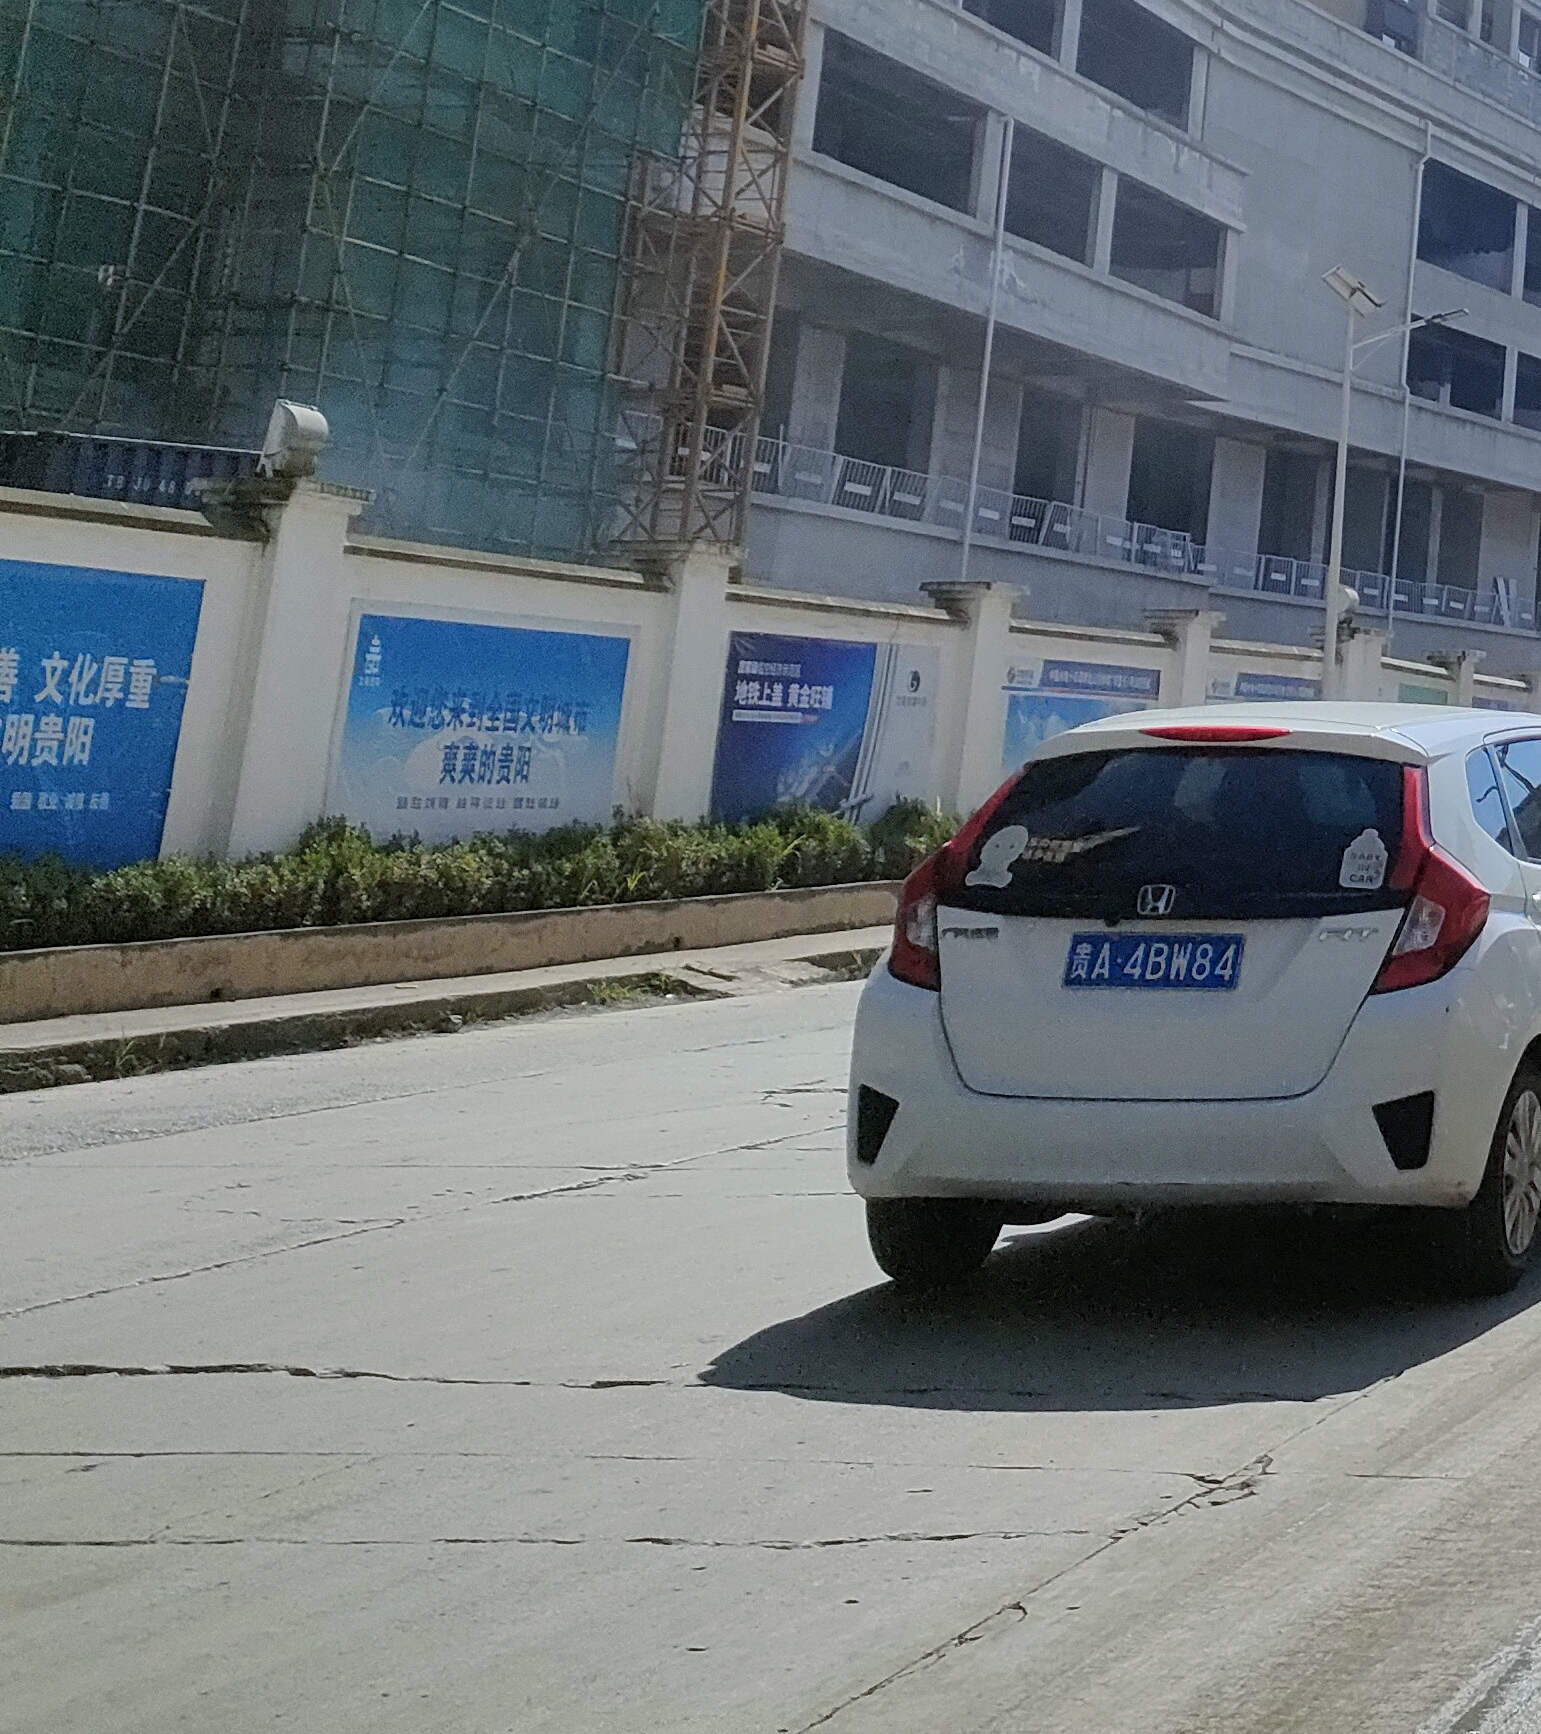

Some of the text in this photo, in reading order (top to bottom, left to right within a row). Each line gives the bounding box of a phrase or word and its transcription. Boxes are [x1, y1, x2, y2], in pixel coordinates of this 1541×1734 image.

[34, 651, 157, 709] 文化厚重
[387, 684, 590, 736] 欢迎您来到全国文明城市
[0, 714, 95, 766] 明贵阳
[439, 740, 532, 785] 爽爽的贵阳
